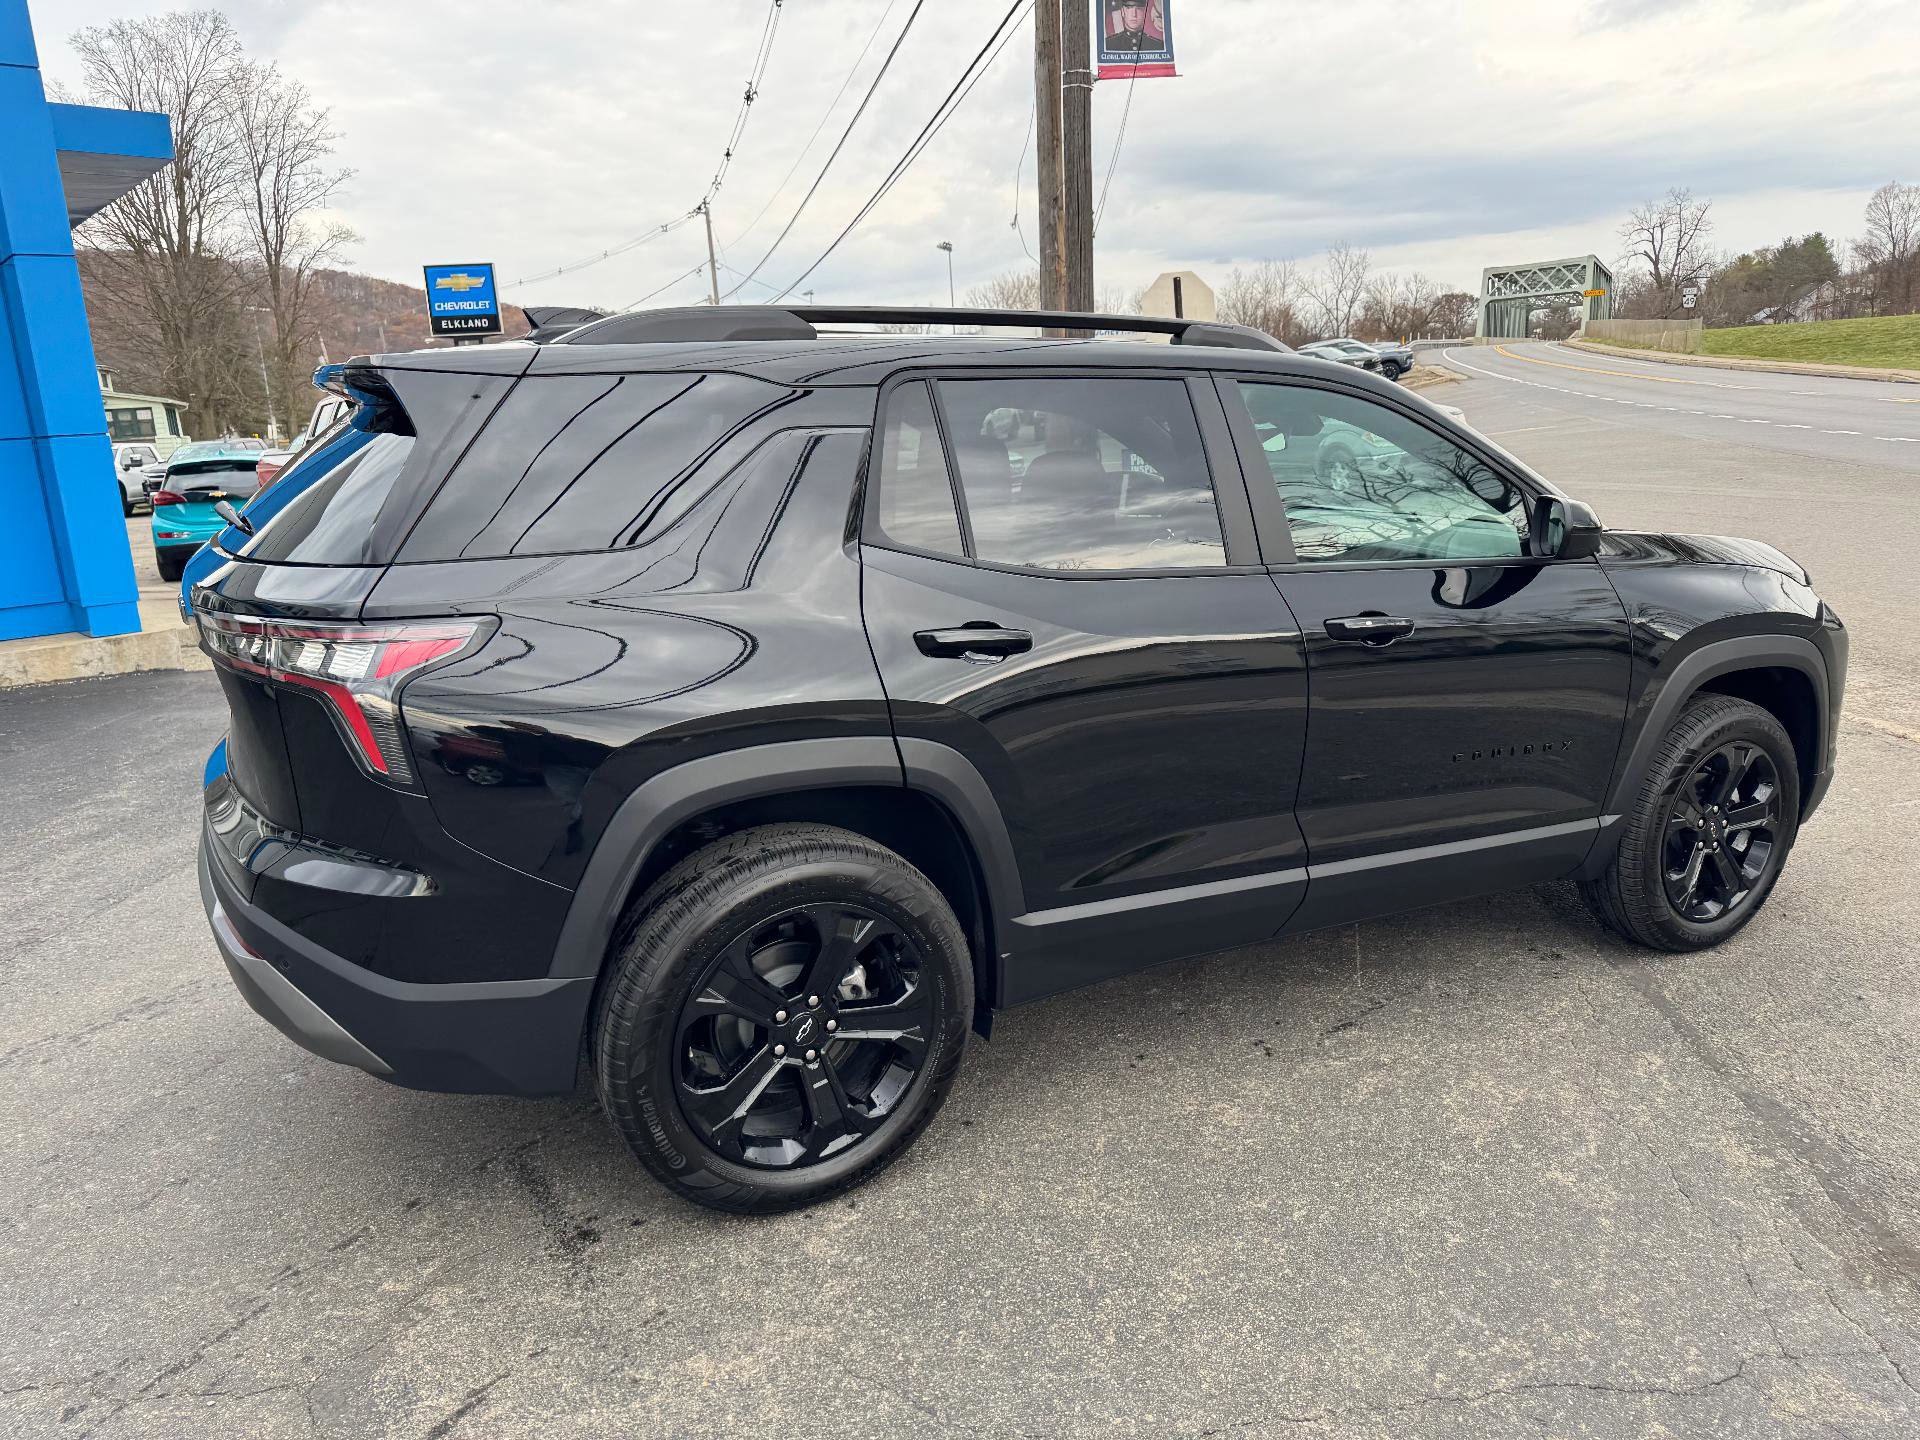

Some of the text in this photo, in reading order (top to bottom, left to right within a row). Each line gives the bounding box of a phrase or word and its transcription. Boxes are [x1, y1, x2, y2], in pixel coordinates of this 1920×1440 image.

[434, 300, 491, 311] CHEVROLET
[1684, 297, 1695, 305] 49
[441, 318, 489, 329] ELKLAND
